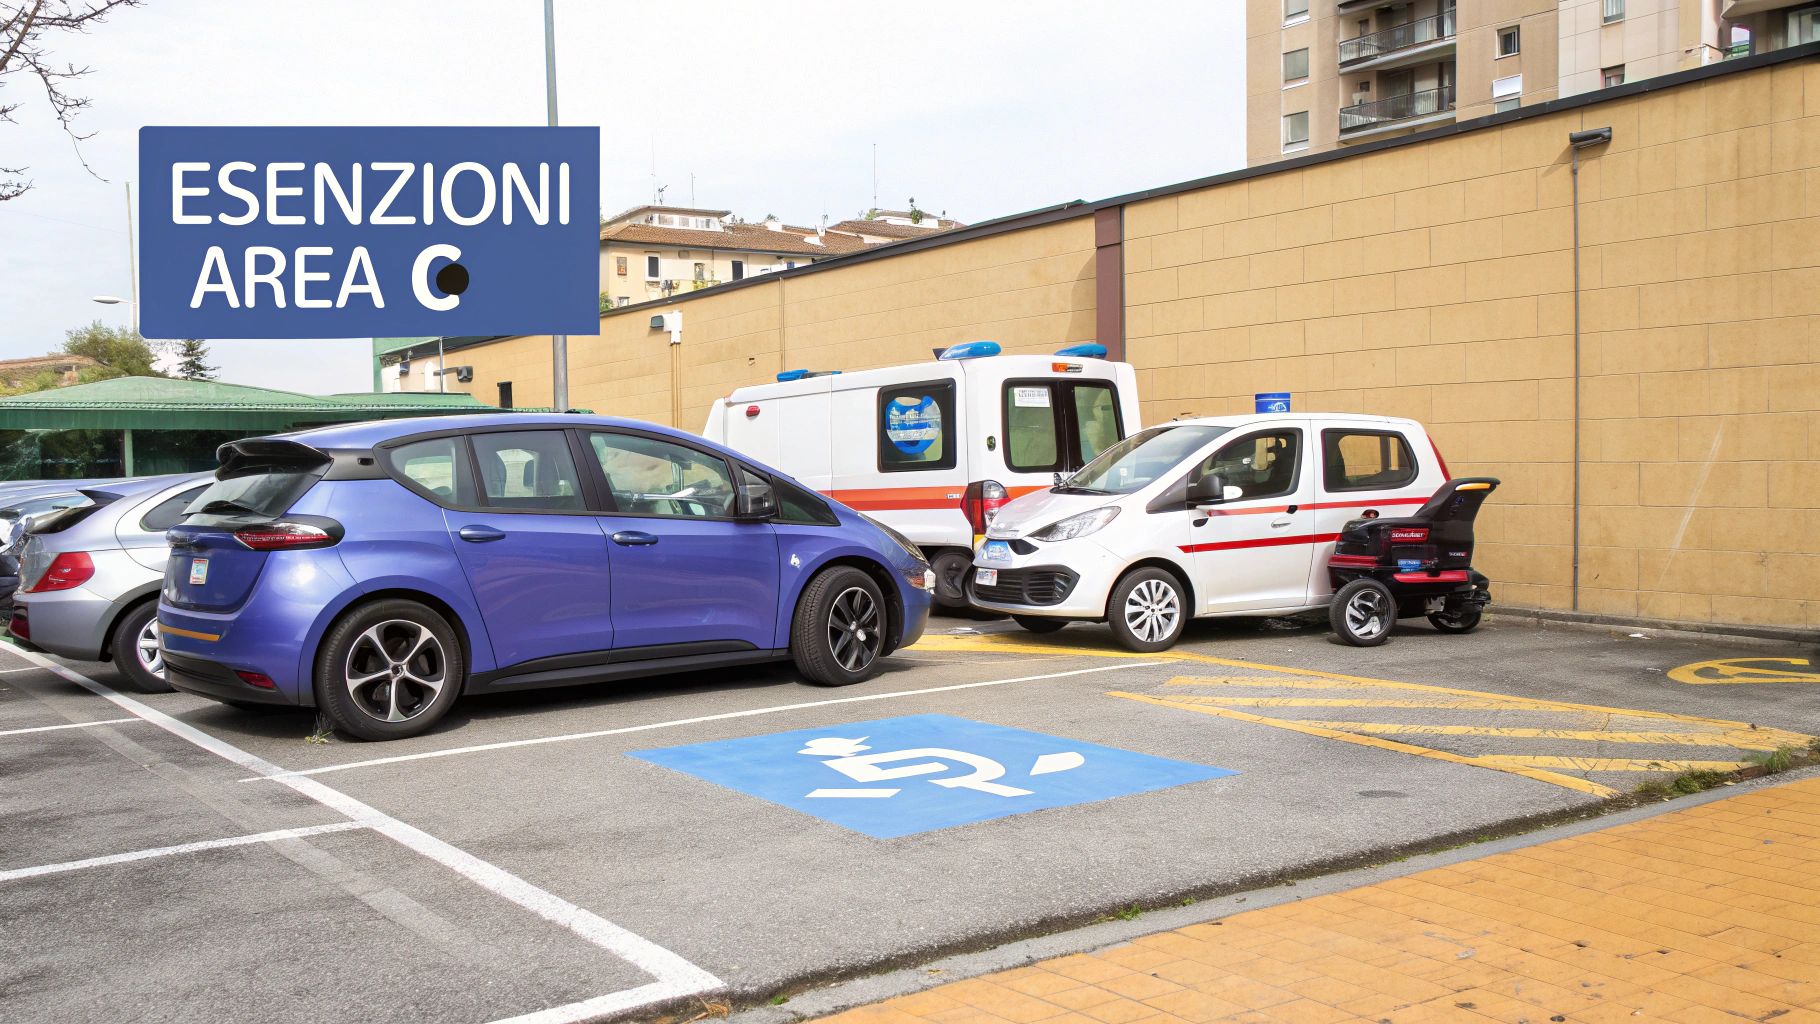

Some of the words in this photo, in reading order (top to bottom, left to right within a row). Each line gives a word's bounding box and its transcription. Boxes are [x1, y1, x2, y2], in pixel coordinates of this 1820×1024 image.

[172, 161, 570, 226] ESENZIONI
[189, 245, 385, 309] AREA
[411, 243, 462, 312] C
